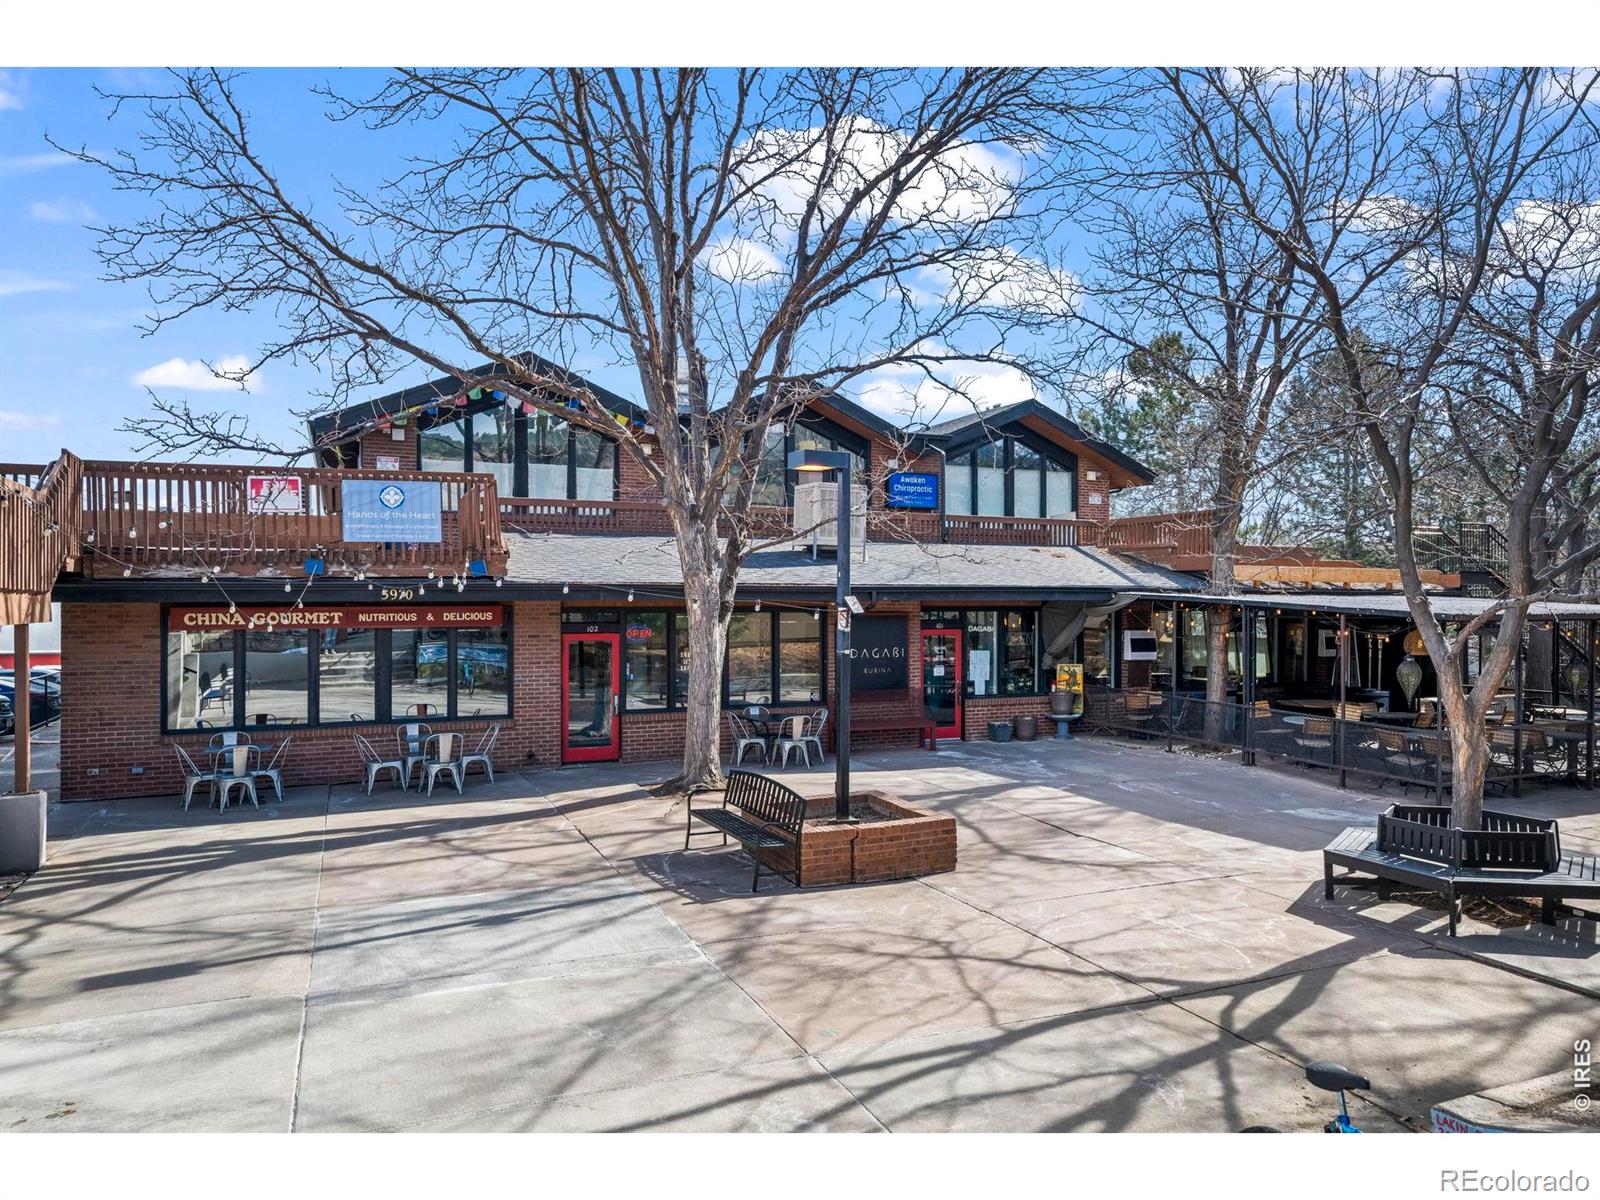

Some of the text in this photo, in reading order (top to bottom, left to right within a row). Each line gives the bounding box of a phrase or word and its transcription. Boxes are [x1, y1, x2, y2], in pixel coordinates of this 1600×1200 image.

[900, 475, 926, 484] Awaken
[893, 484, 933, 493] Chiropractic
[380, 511, 390, 520] of
[183, 611, 343, 626] CHINA GOURMET
[358, 612, 493, 622] NUTRITIOUS & DELICIOUS
[587, 625, 599, 633] 102
[626, 628, 652, 638] OPEN
[968, 625, 994, 633] DAGABI
[850, 646, 905, 659] DAGABI
